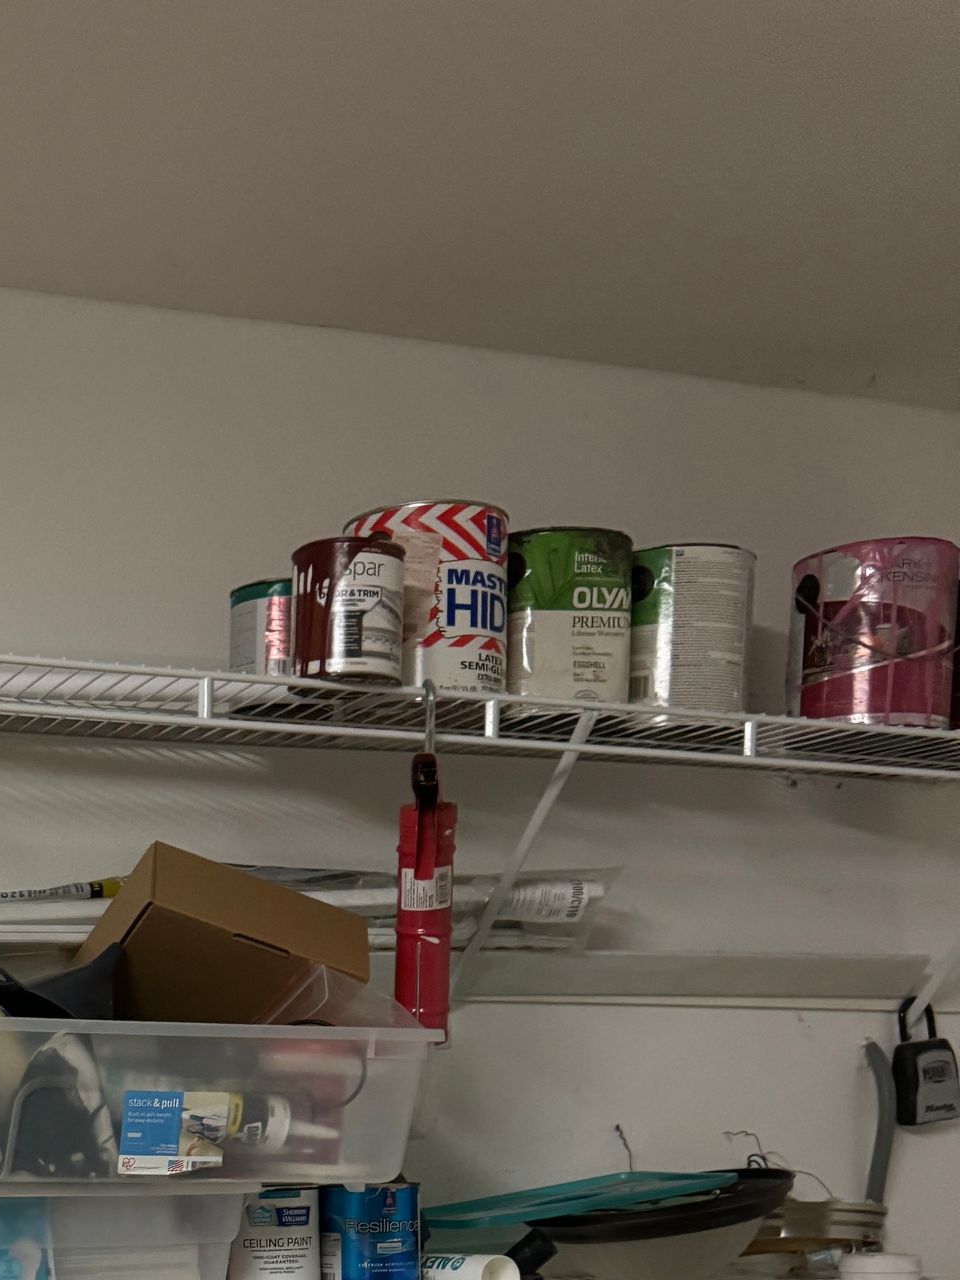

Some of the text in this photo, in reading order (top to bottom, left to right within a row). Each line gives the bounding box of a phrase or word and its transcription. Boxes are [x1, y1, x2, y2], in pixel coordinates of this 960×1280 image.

[574, 561, 603, 573] Latex
[357, 589, 380, 598] TRIM
[128, 1098, 180, 1110] stack & pull
[243, 1236, 313, 1249] CEILING PAINT
